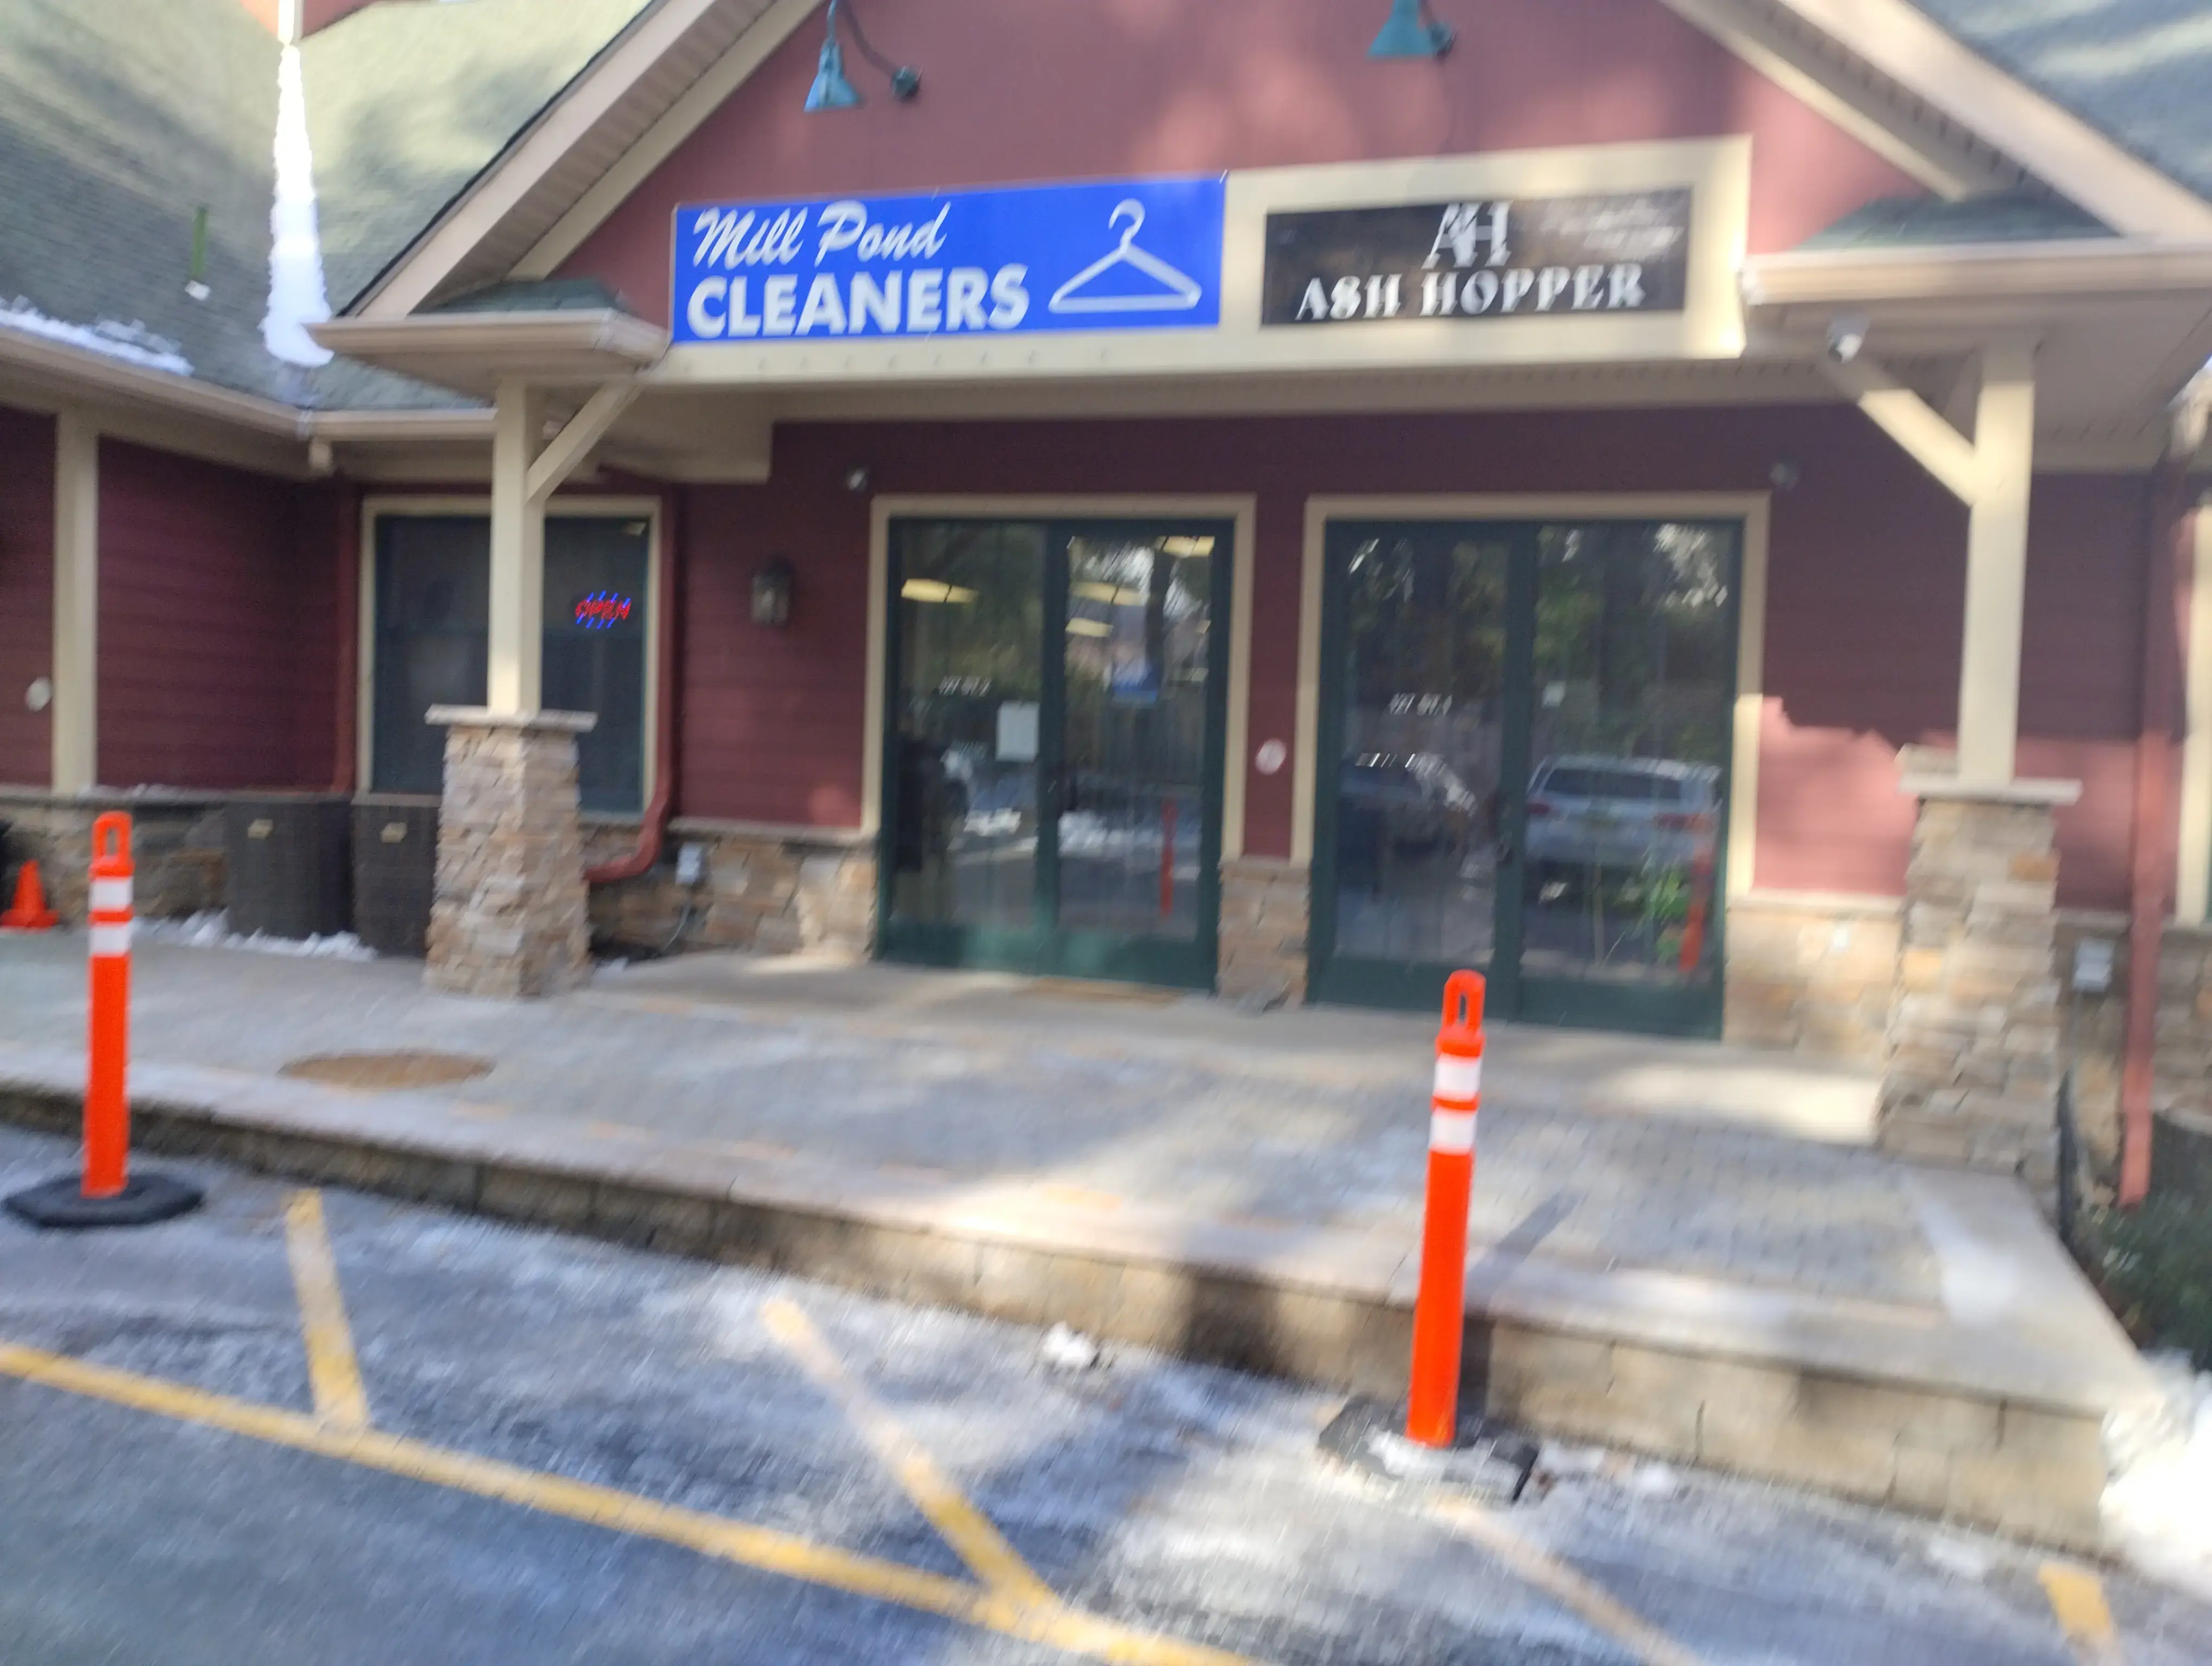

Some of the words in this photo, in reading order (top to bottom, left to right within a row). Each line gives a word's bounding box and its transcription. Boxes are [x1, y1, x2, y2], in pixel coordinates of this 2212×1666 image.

[692, 206, 808, 270] Mill
[814, 200, 950, 266] Pond
[686, 263, 1030, 338] CLEANERS
[1295, 272, 1403, 321] ASH
[1419, 262, 1645, 317] HOPPER
[574, 599, 632, 620] OPEN
